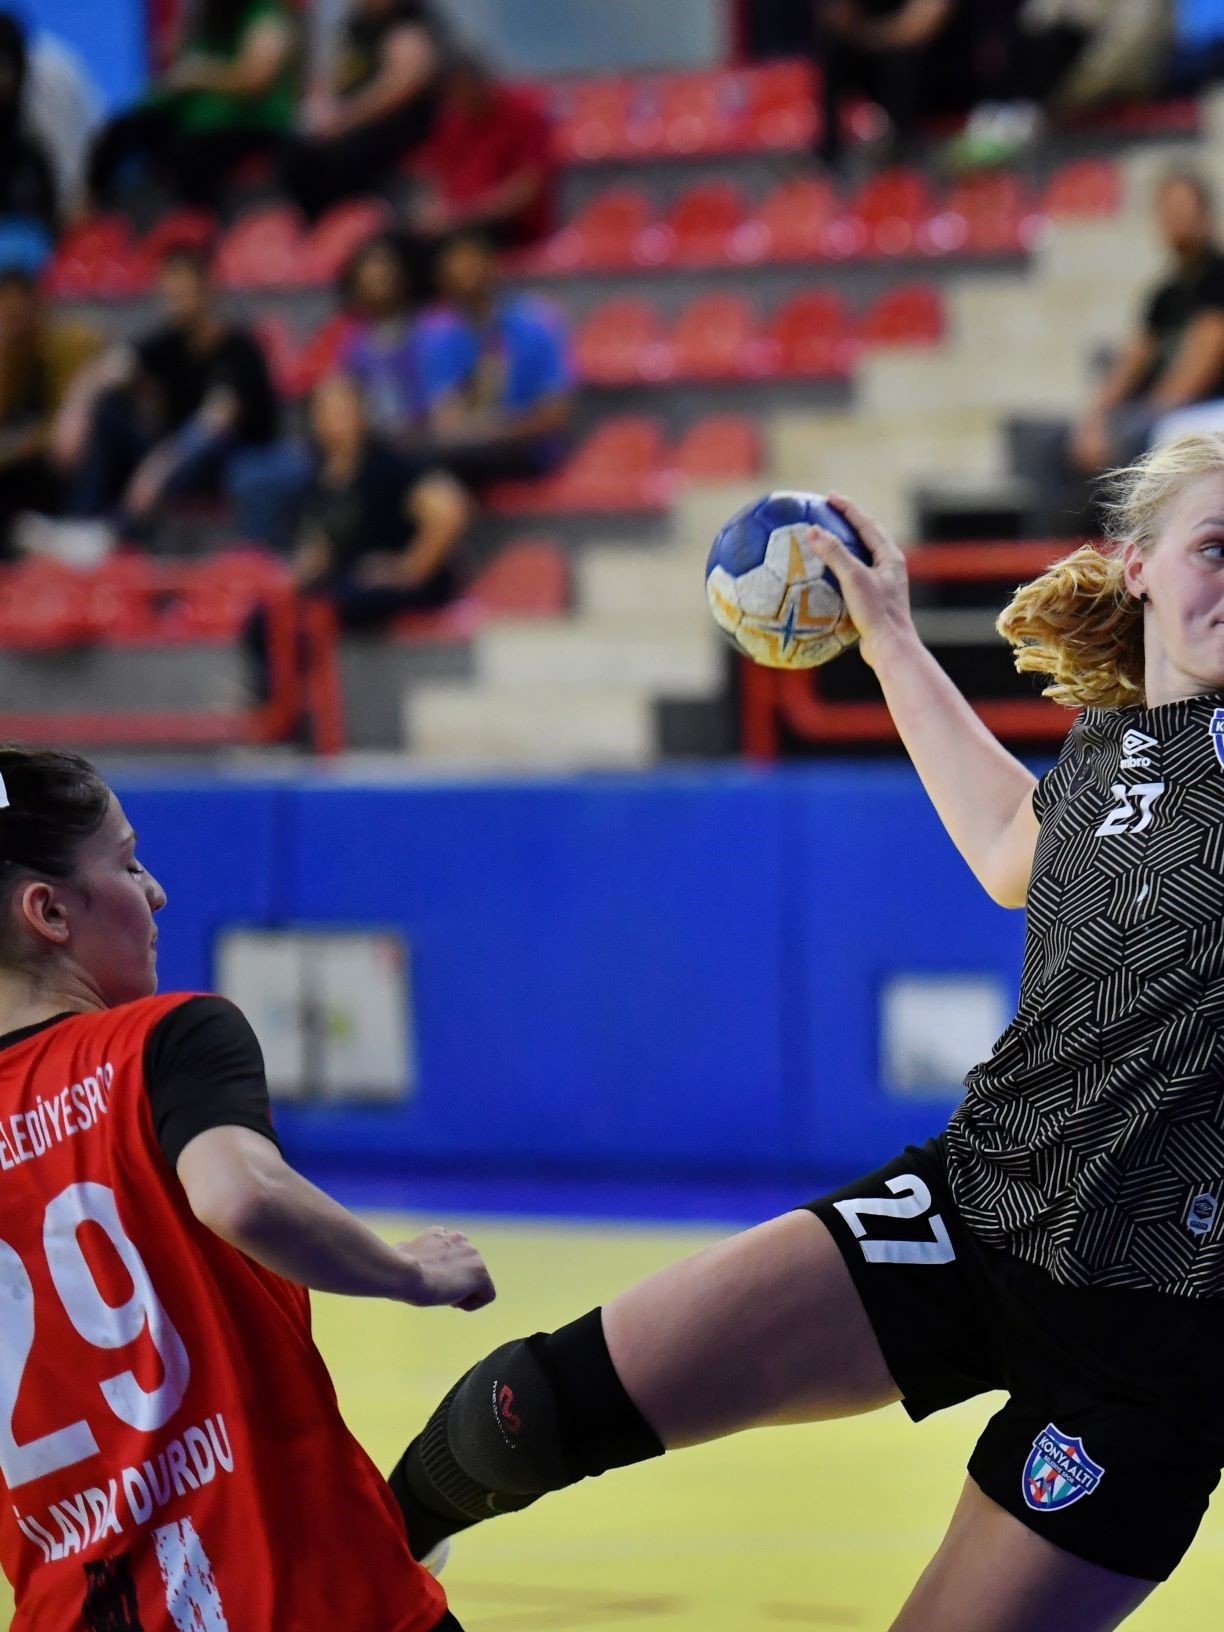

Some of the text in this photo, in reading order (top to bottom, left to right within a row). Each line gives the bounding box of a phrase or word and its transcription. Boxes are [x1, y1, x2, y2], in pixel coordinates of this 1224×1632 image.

[1094, 782, 1165, 837] 27
[832, 1174, 956, 1264] 27
[0, 1181, 190, 1489] 29
[121, 1413, 234, 1525] DURDU
[1039, 1436, 1094, 1488] KONYAALTI
